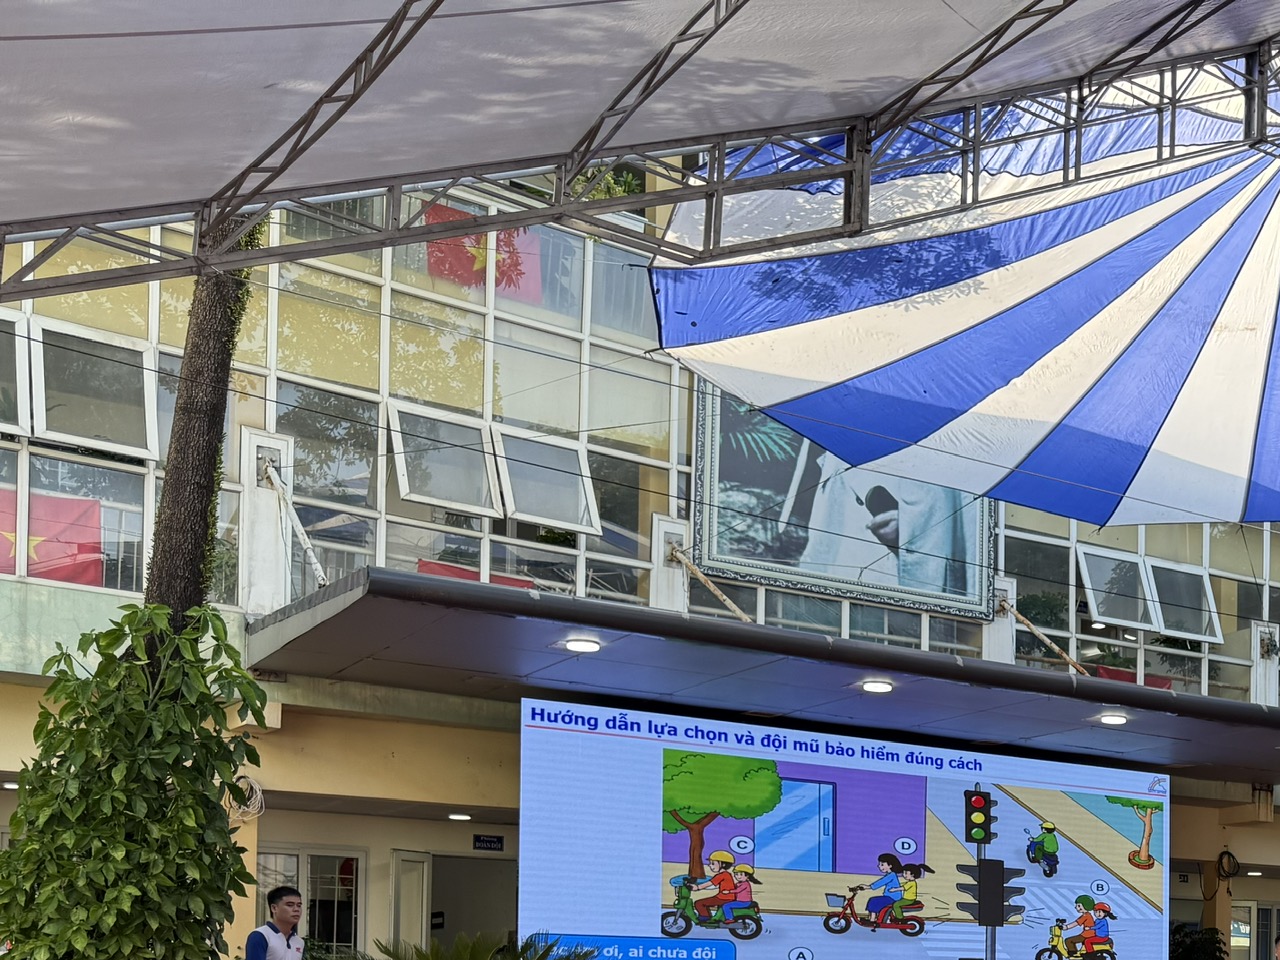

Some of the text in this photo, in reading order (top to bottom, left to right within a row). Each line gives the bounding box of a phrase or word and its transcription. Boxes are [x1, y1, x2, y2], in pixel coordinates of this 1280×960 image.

[531, 707, 983, 771] Hướng dẫn lựa chọn và đội mũ bảo hiểm đúng cách
[736, 840, 748, 849] C
[901, 841, 911, 850] D
[1096, 883, 1104, 891] B
[603, 945, 623, 959] ơi,
[628, 945, 644, 958] ai
[648, 946, 687, 959] chưa
[796, 951, 807, 960] A
